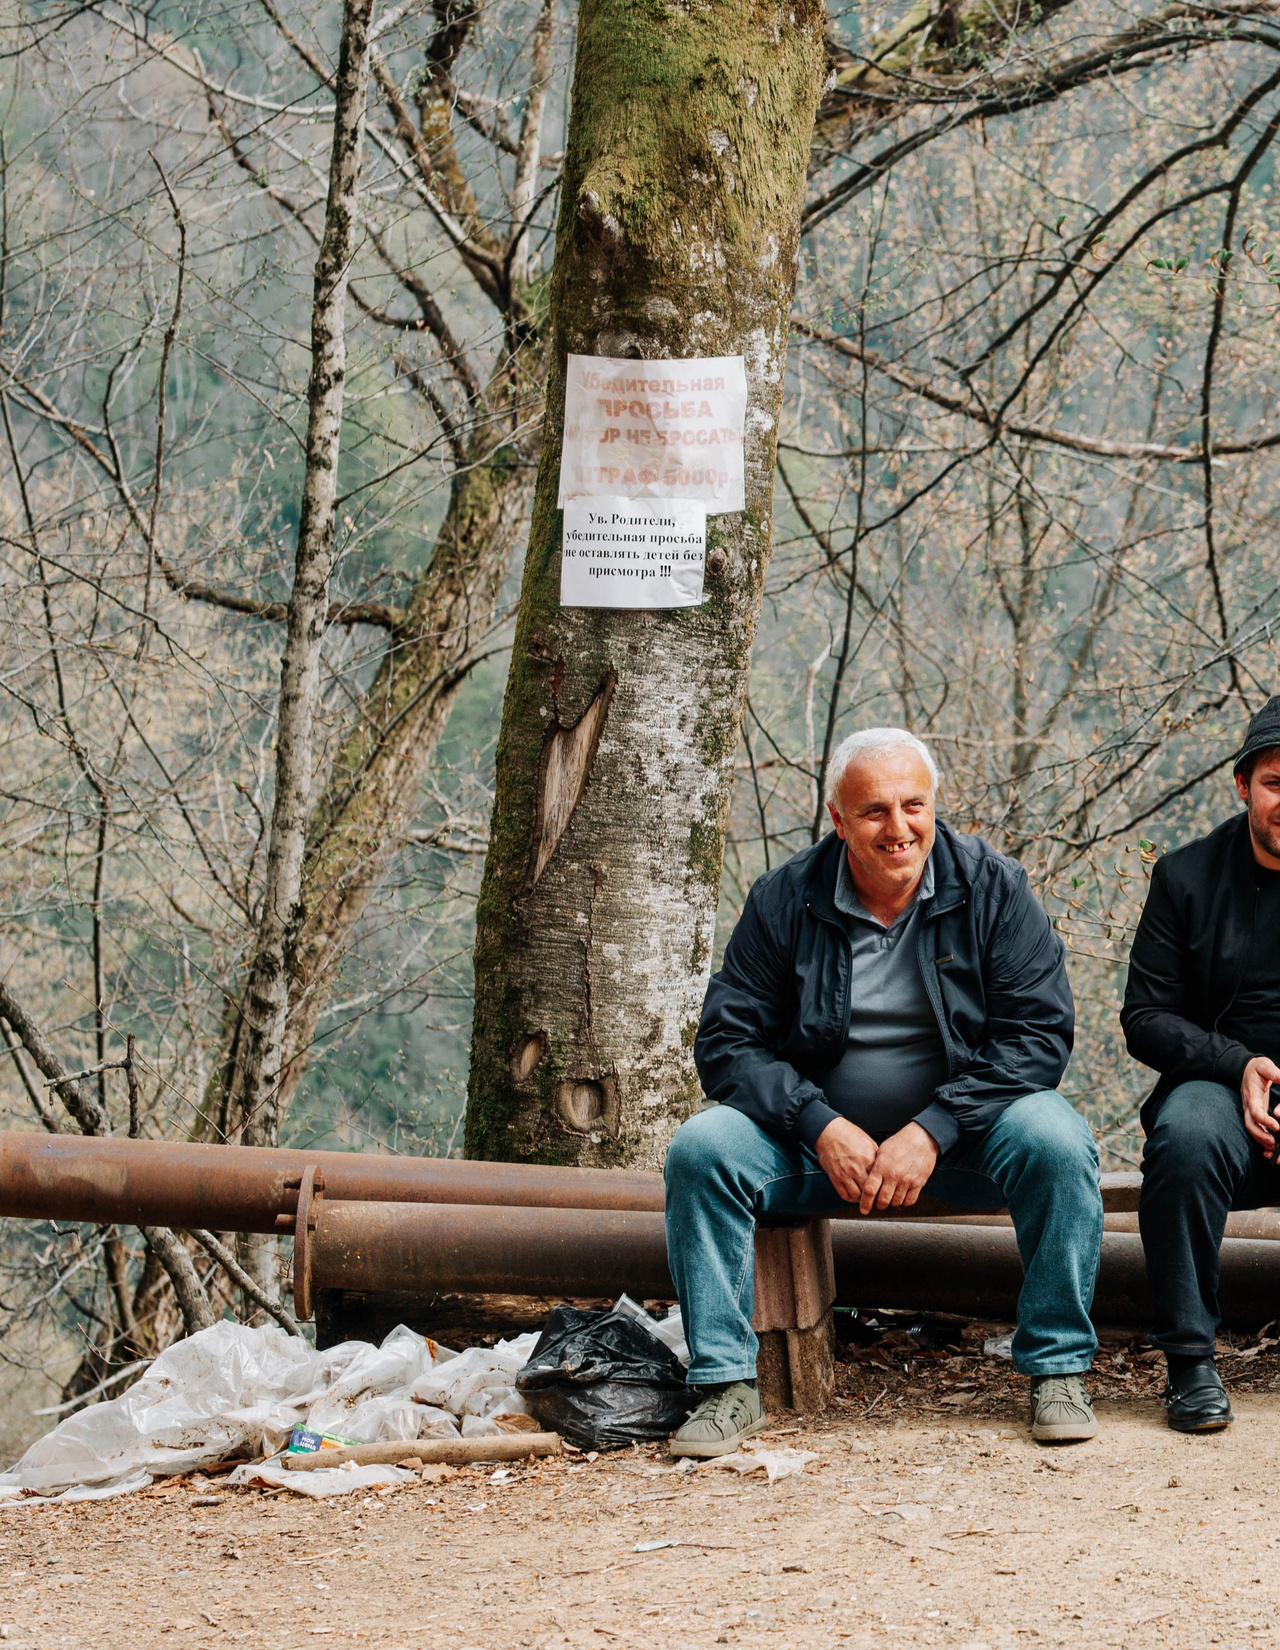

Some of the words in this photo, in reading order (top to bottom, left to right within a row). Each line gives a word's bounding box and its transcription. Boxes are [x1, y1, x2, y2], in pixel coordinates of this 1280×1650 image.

[597, 399, 713, 419] ПРОСЬБА
[589, 513, 607, 524] Ув.
[612, 514, 676, 528] Родители,
[566, 530, 645, 543] убедительная
[650, 534, 702, 546] просьба
[565, 549, 577, 558] не
[579, 549, 639, 559] оставлять
[643, 549, 679, 561] детей
[683, 550, 703, 561] без
[589, 567, 656, 580] присмотра
[660, 565, 671, 577] !!!
